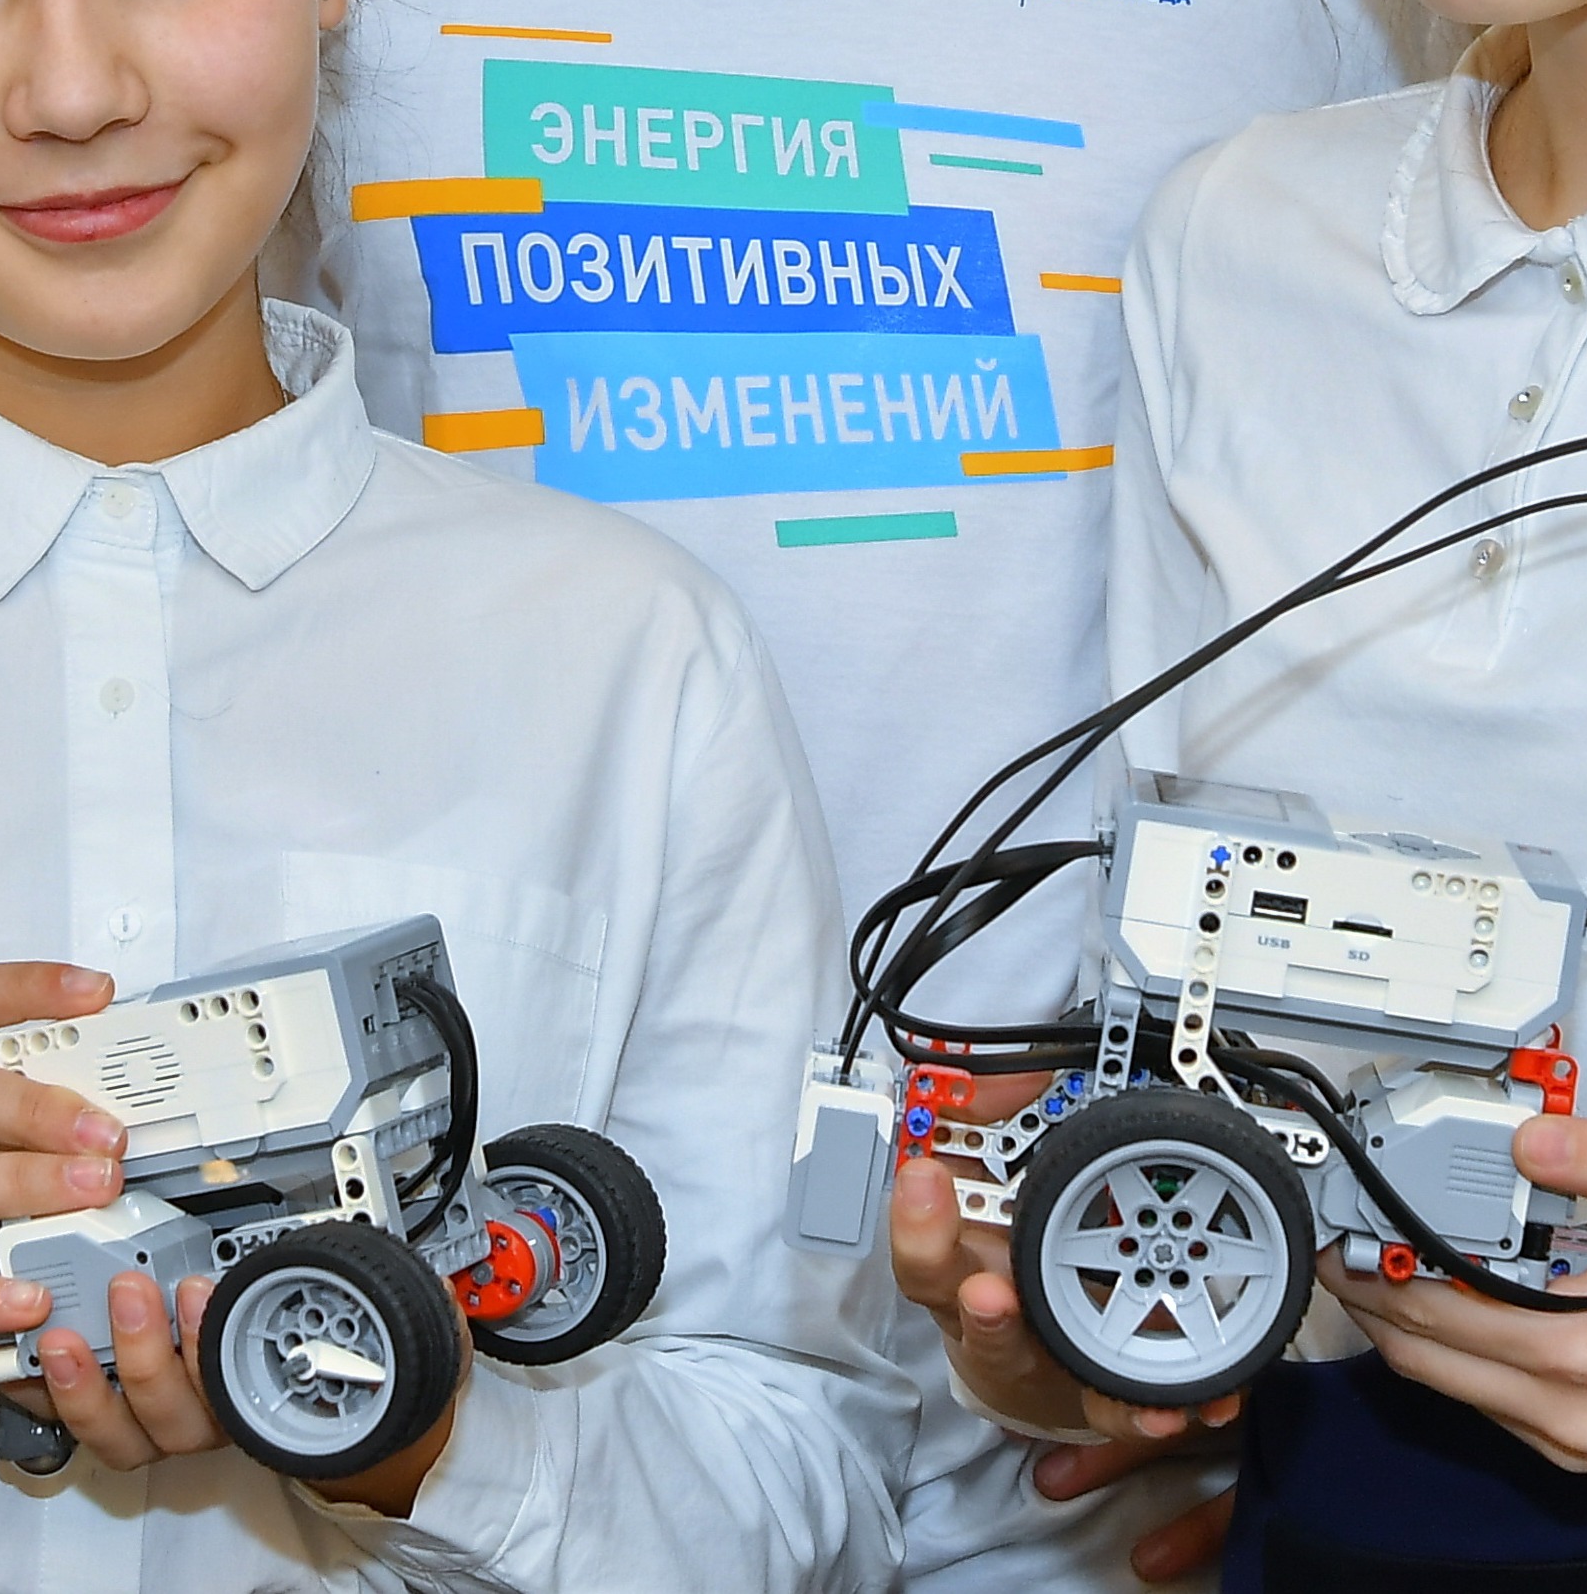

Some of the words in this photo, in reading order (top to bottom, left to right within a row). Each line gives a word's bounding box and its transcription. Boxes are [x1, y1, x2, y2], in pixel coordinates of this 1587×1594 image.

[529, 101, 861, 179] ЭНЕРГИЯ
[460, 232, 974, 310] ПОЗИТИВНЫХ
[566, 357, 1019, 453] ИЗМЕНЕНИЙ
[1257, 935, 1291, 949] USB
[1347, 949, 1371, 962] SD
